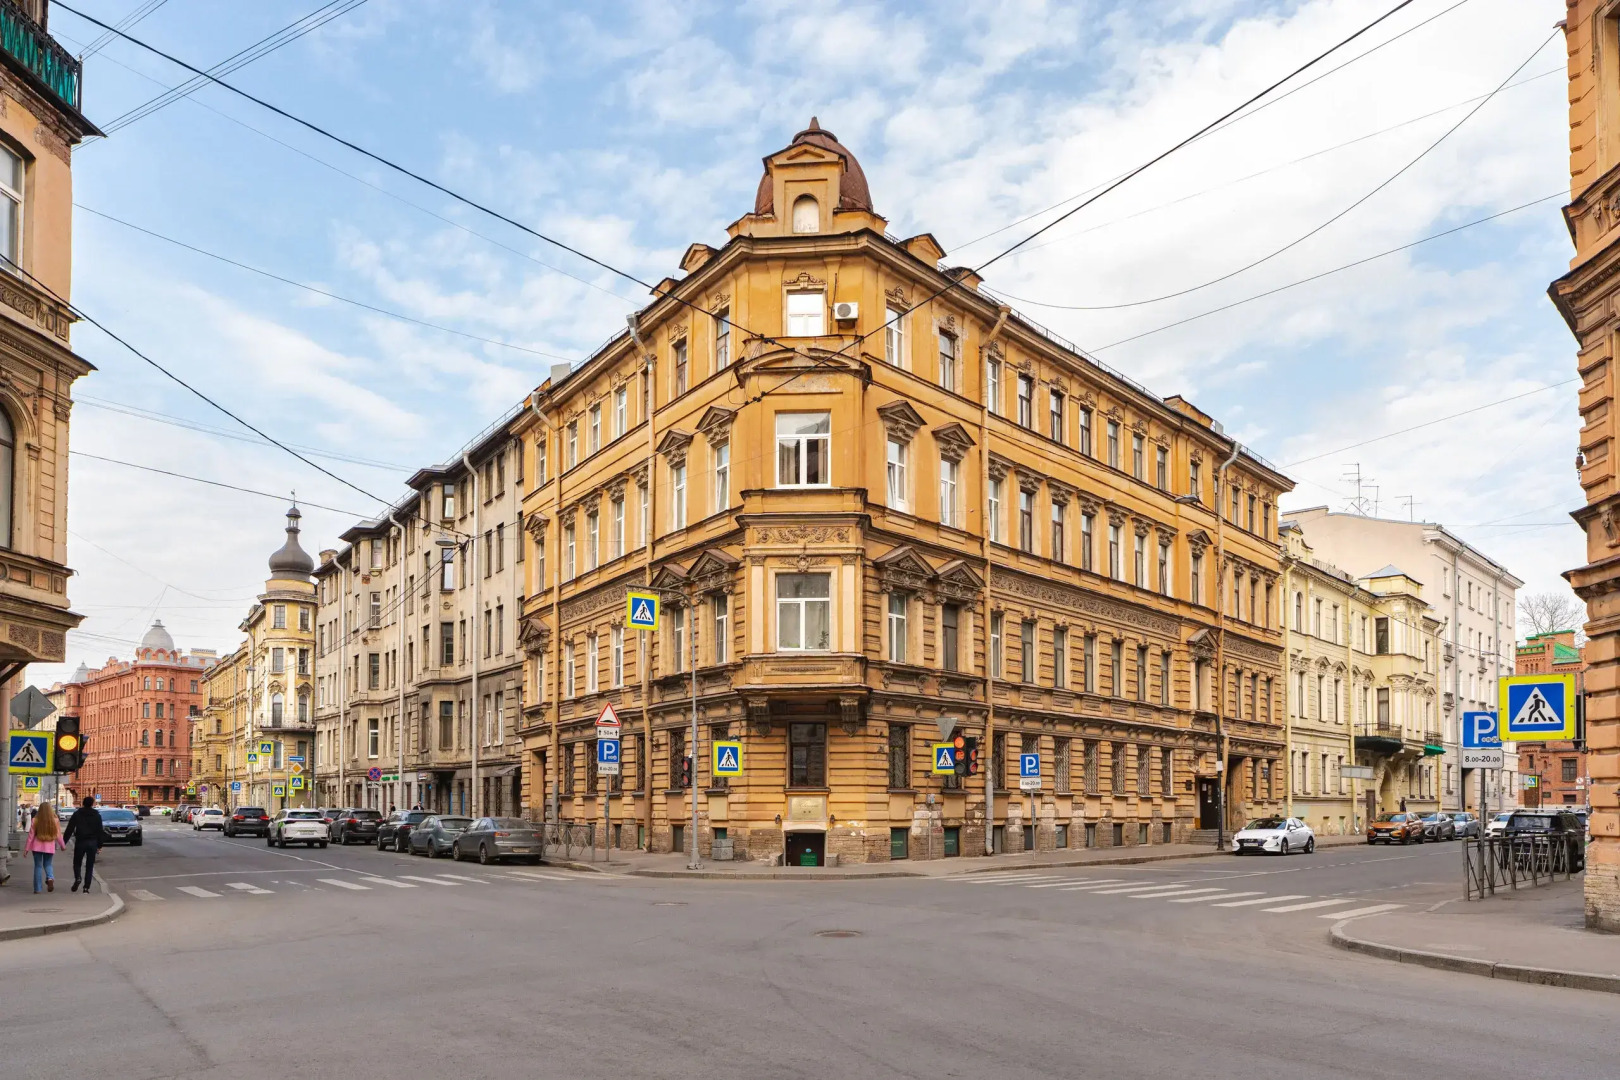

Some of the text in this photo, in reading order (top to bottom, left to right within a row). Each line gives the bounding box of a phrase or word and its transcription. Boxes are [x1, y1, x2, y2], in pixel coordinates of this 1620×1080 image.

[1473, 715, 1495, 744] P
[603, 742, 615, 760] P
[1464, 755, 1501, 763] 8.00-20.00
[1025, 756, 1036, 774] P
